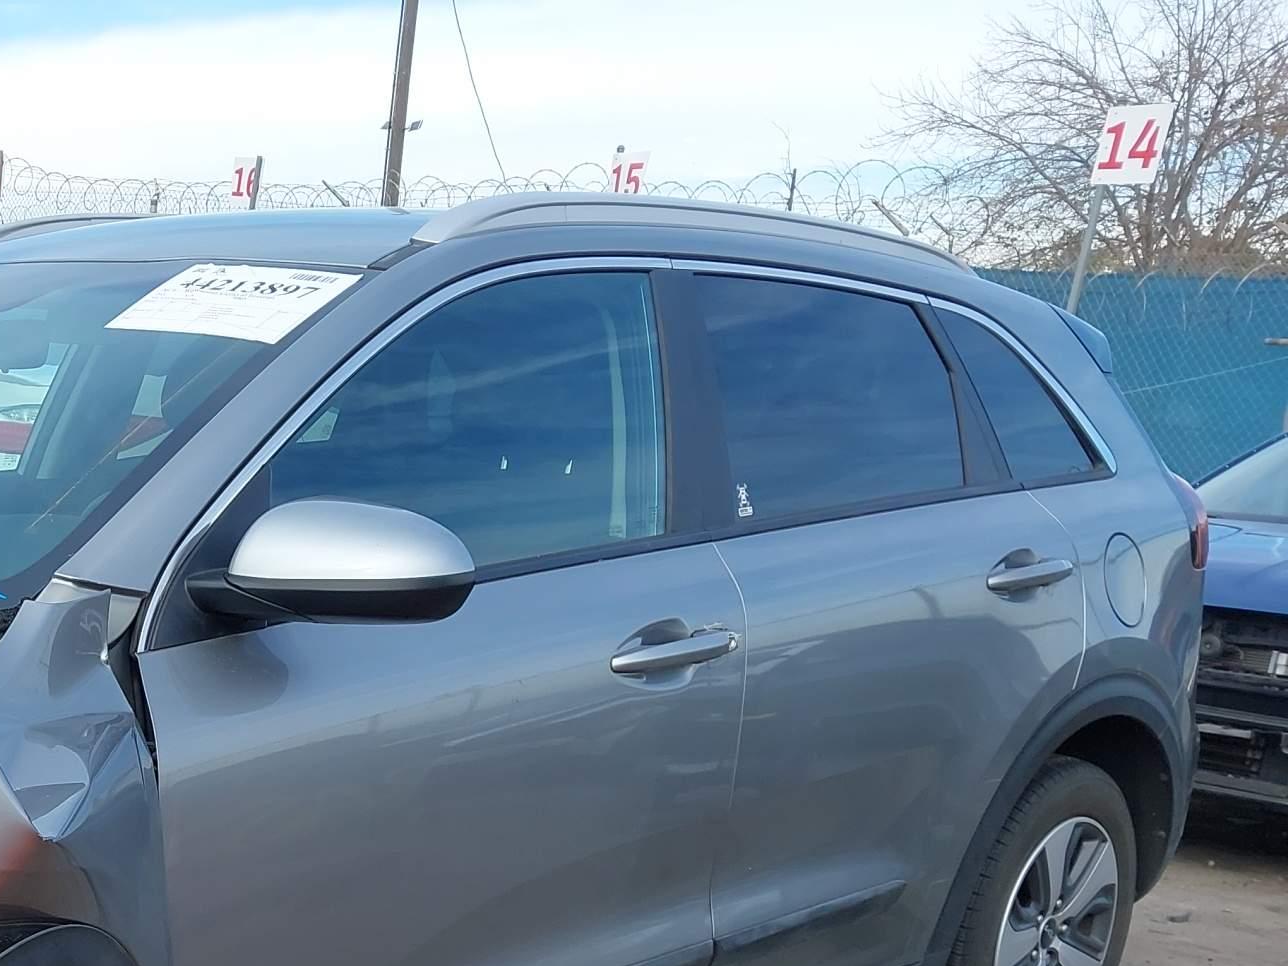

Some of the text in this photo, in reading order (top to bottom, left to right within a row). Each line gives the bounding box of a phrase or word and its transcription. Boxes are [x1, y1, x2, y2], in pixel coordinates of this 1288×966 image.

[1097, 119, 1160, 169] 14
[613, 162, 644, 194] 15
[180, 277, 320, 299] 44213897
